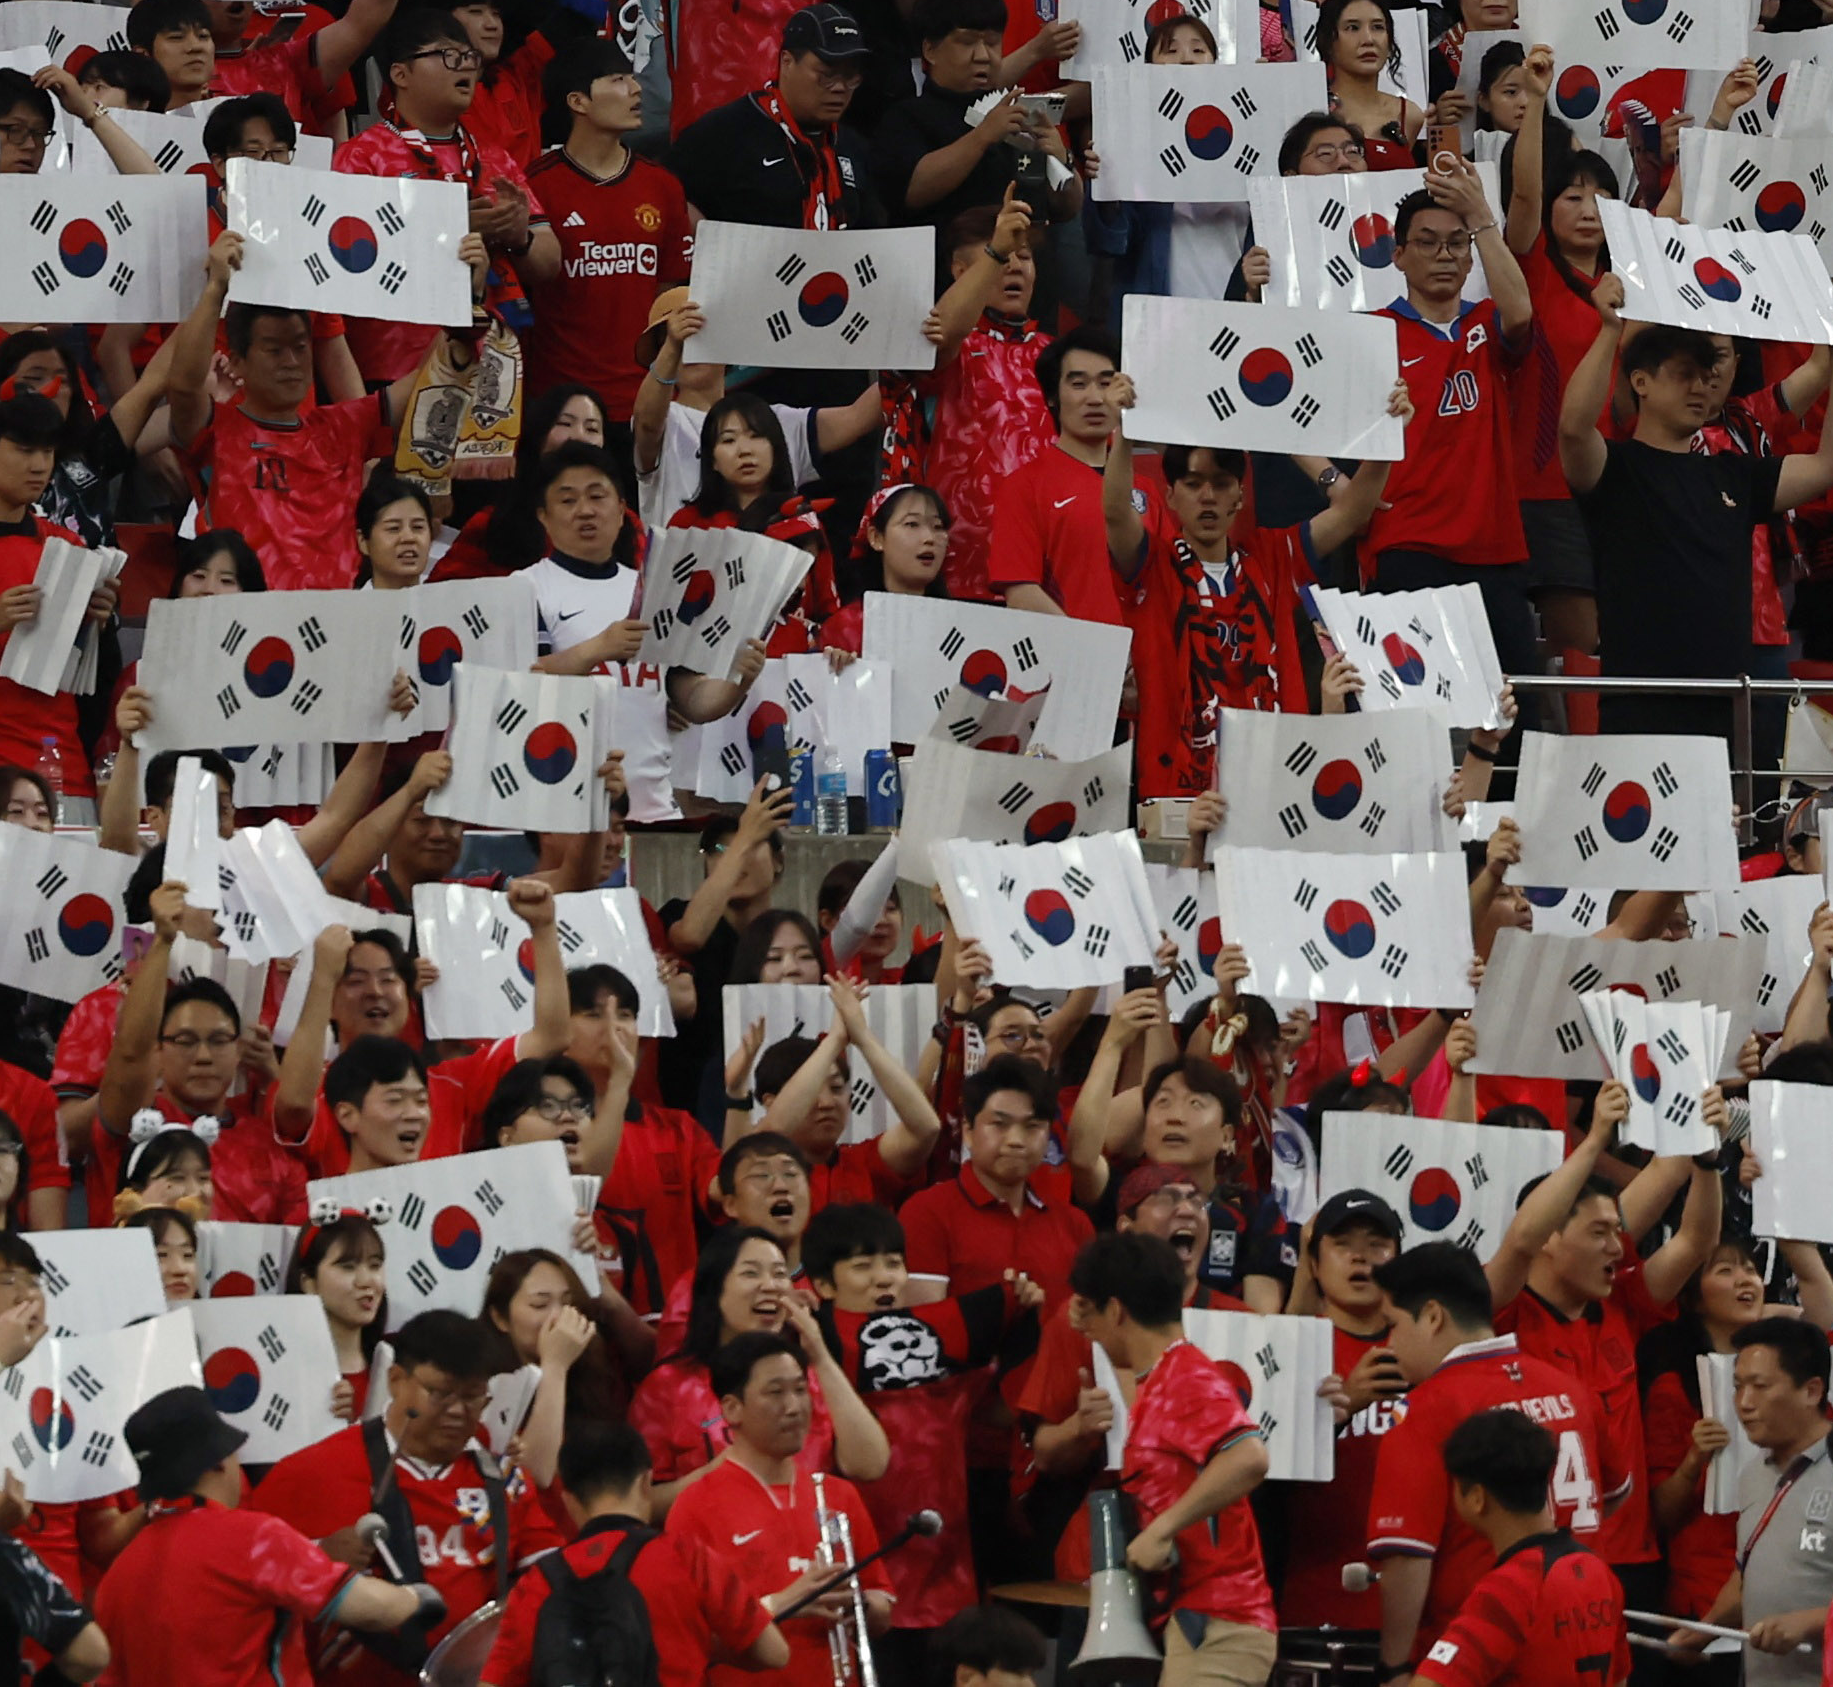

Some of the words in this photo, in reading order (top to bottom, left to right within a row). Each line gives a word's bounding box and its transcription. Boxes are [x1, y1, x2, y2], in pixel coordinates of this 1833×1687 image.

[578, 240, 635, 261] Team
[564, 255, 633, 280] Viewer
[1438, 372, 1478, 418] 20
[1799, 1527, 1825, 1553] kt
